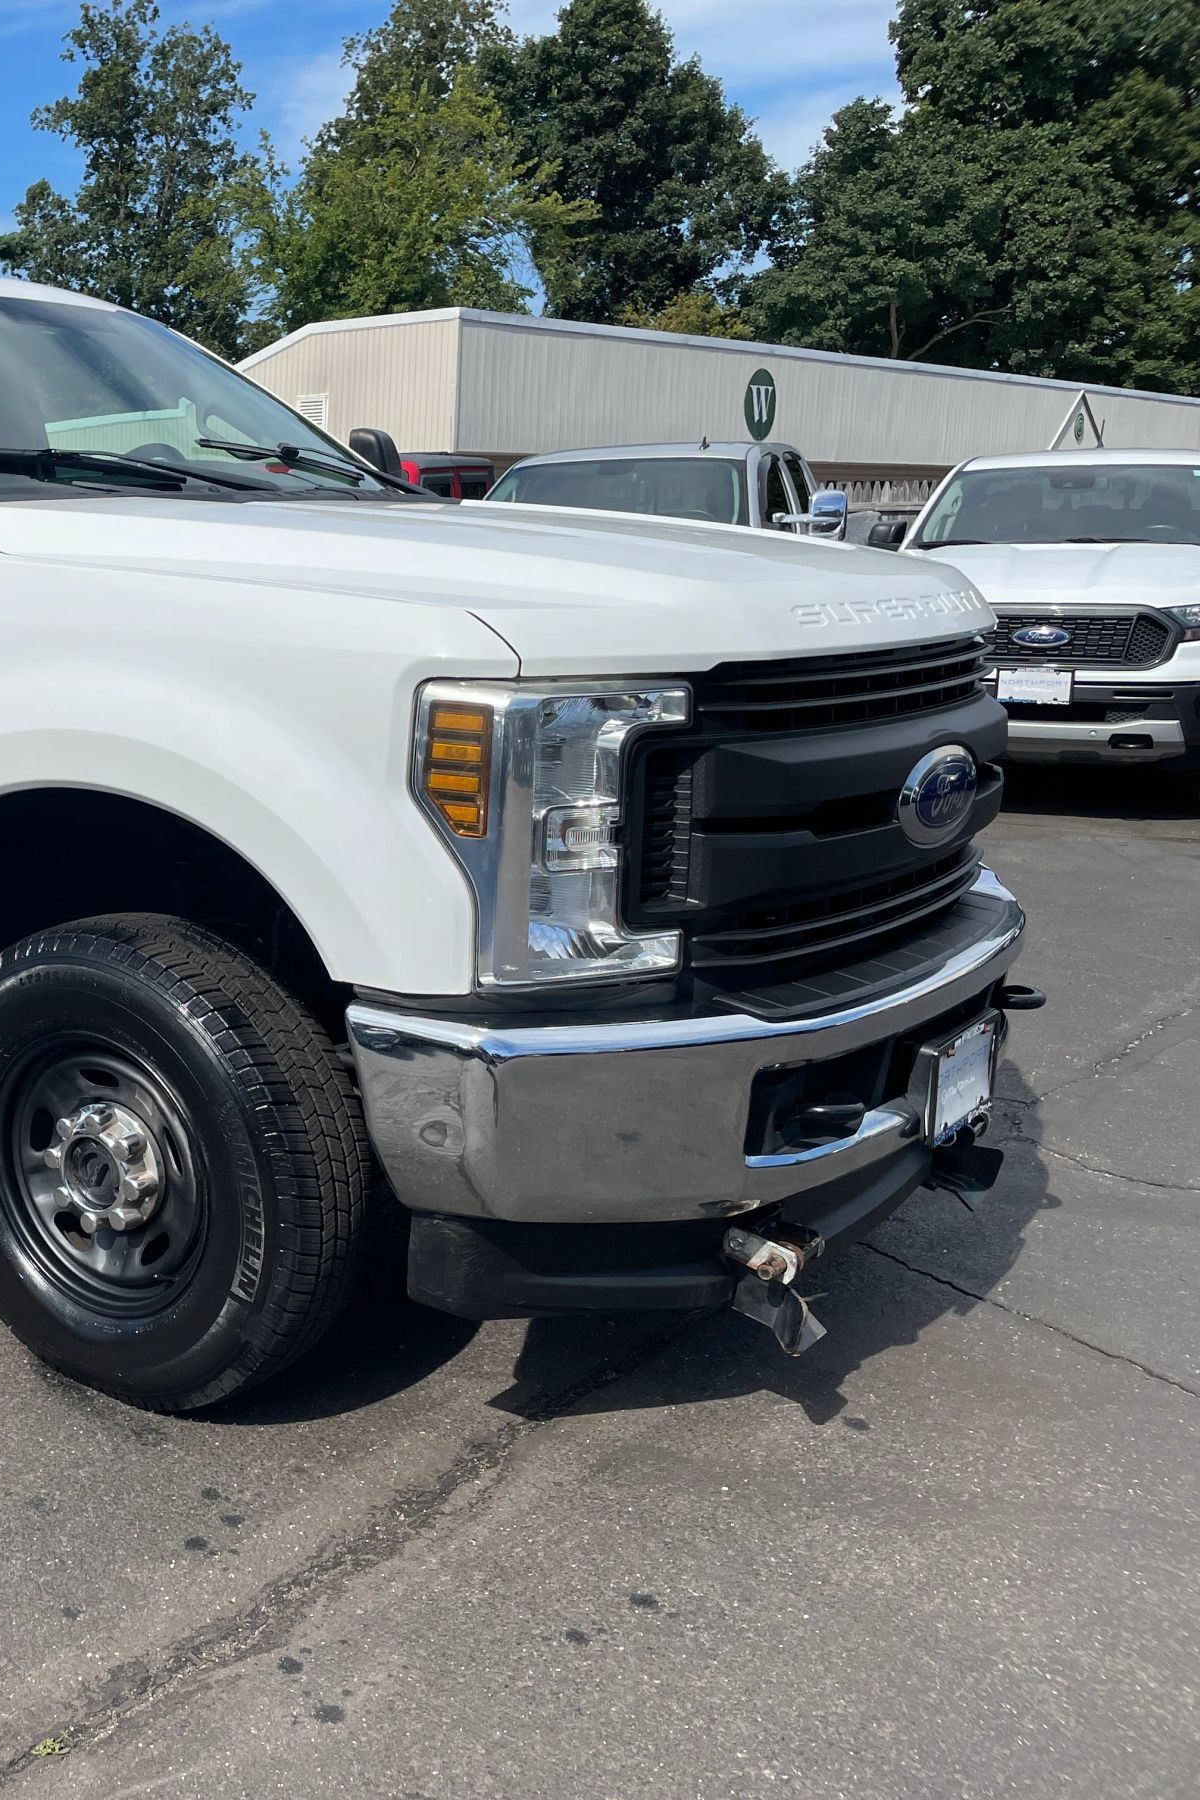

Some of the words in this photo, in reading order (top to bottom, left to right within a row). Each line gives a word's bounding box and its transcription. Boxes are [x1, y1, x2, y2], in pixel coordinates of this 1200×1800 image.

[749, 384, 774, 424] W
[1000, 678, 1069, 687] NORTHPORT
[231, 1143, 264, 1300] MICHELIN
